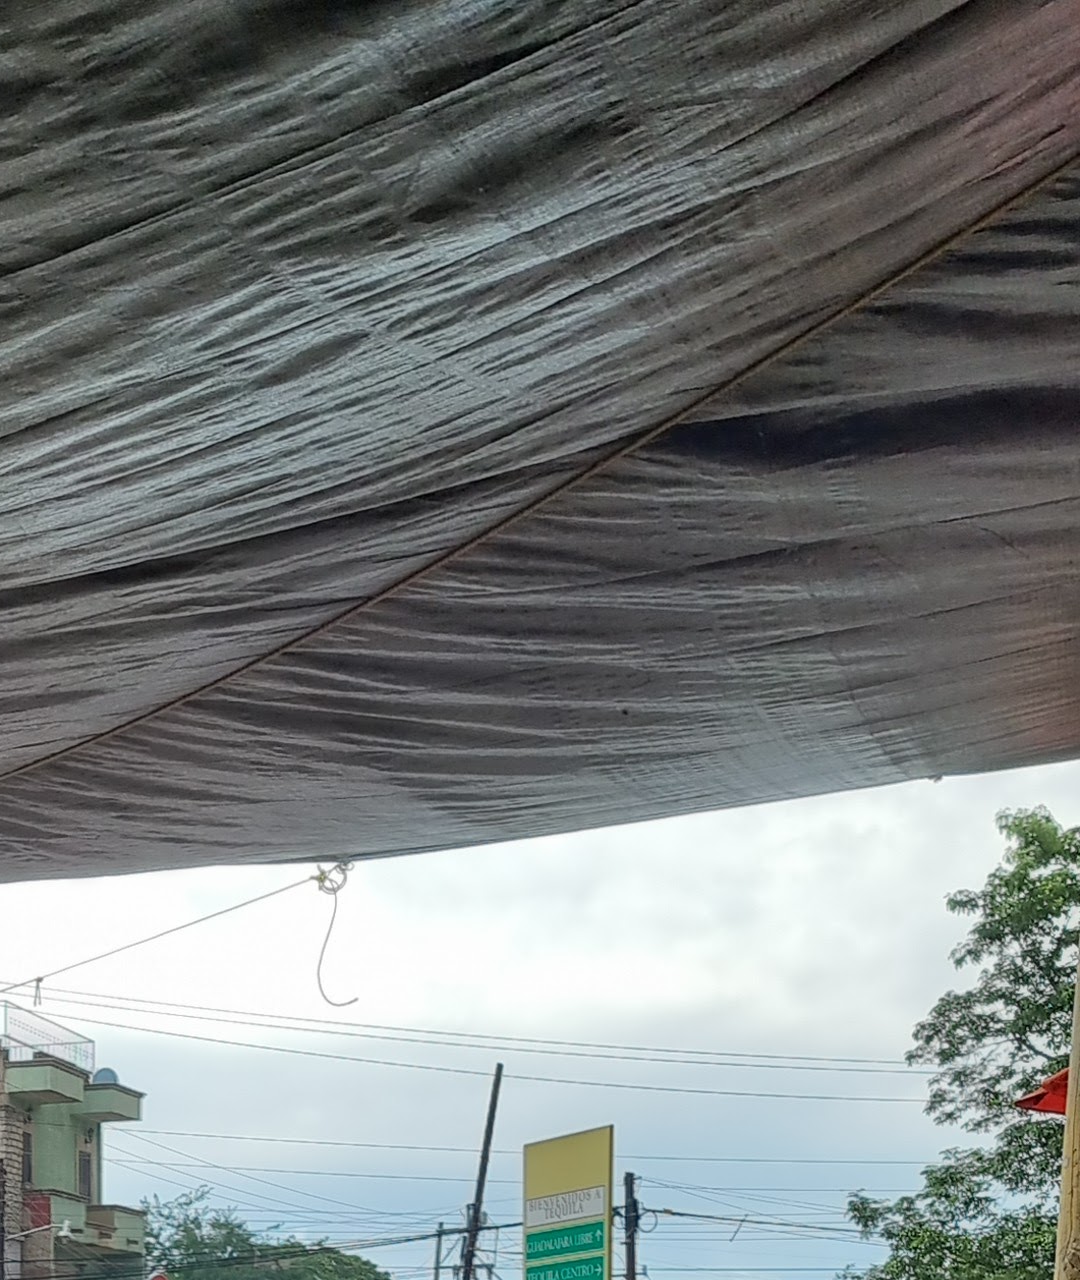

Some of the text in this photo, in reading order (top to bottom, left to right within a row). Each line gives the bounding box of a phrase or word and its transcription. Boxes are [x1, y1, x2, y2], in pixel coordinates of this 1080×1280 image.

[529, 1188, 602, 1212] BIENVENIDOS A
[544, 1203, 584, 1219] TEQUILA
[527, 1232, 593, 1253] GUADALAJARA LIBRE
[560, 1264, 594, 1280] CENTRO
